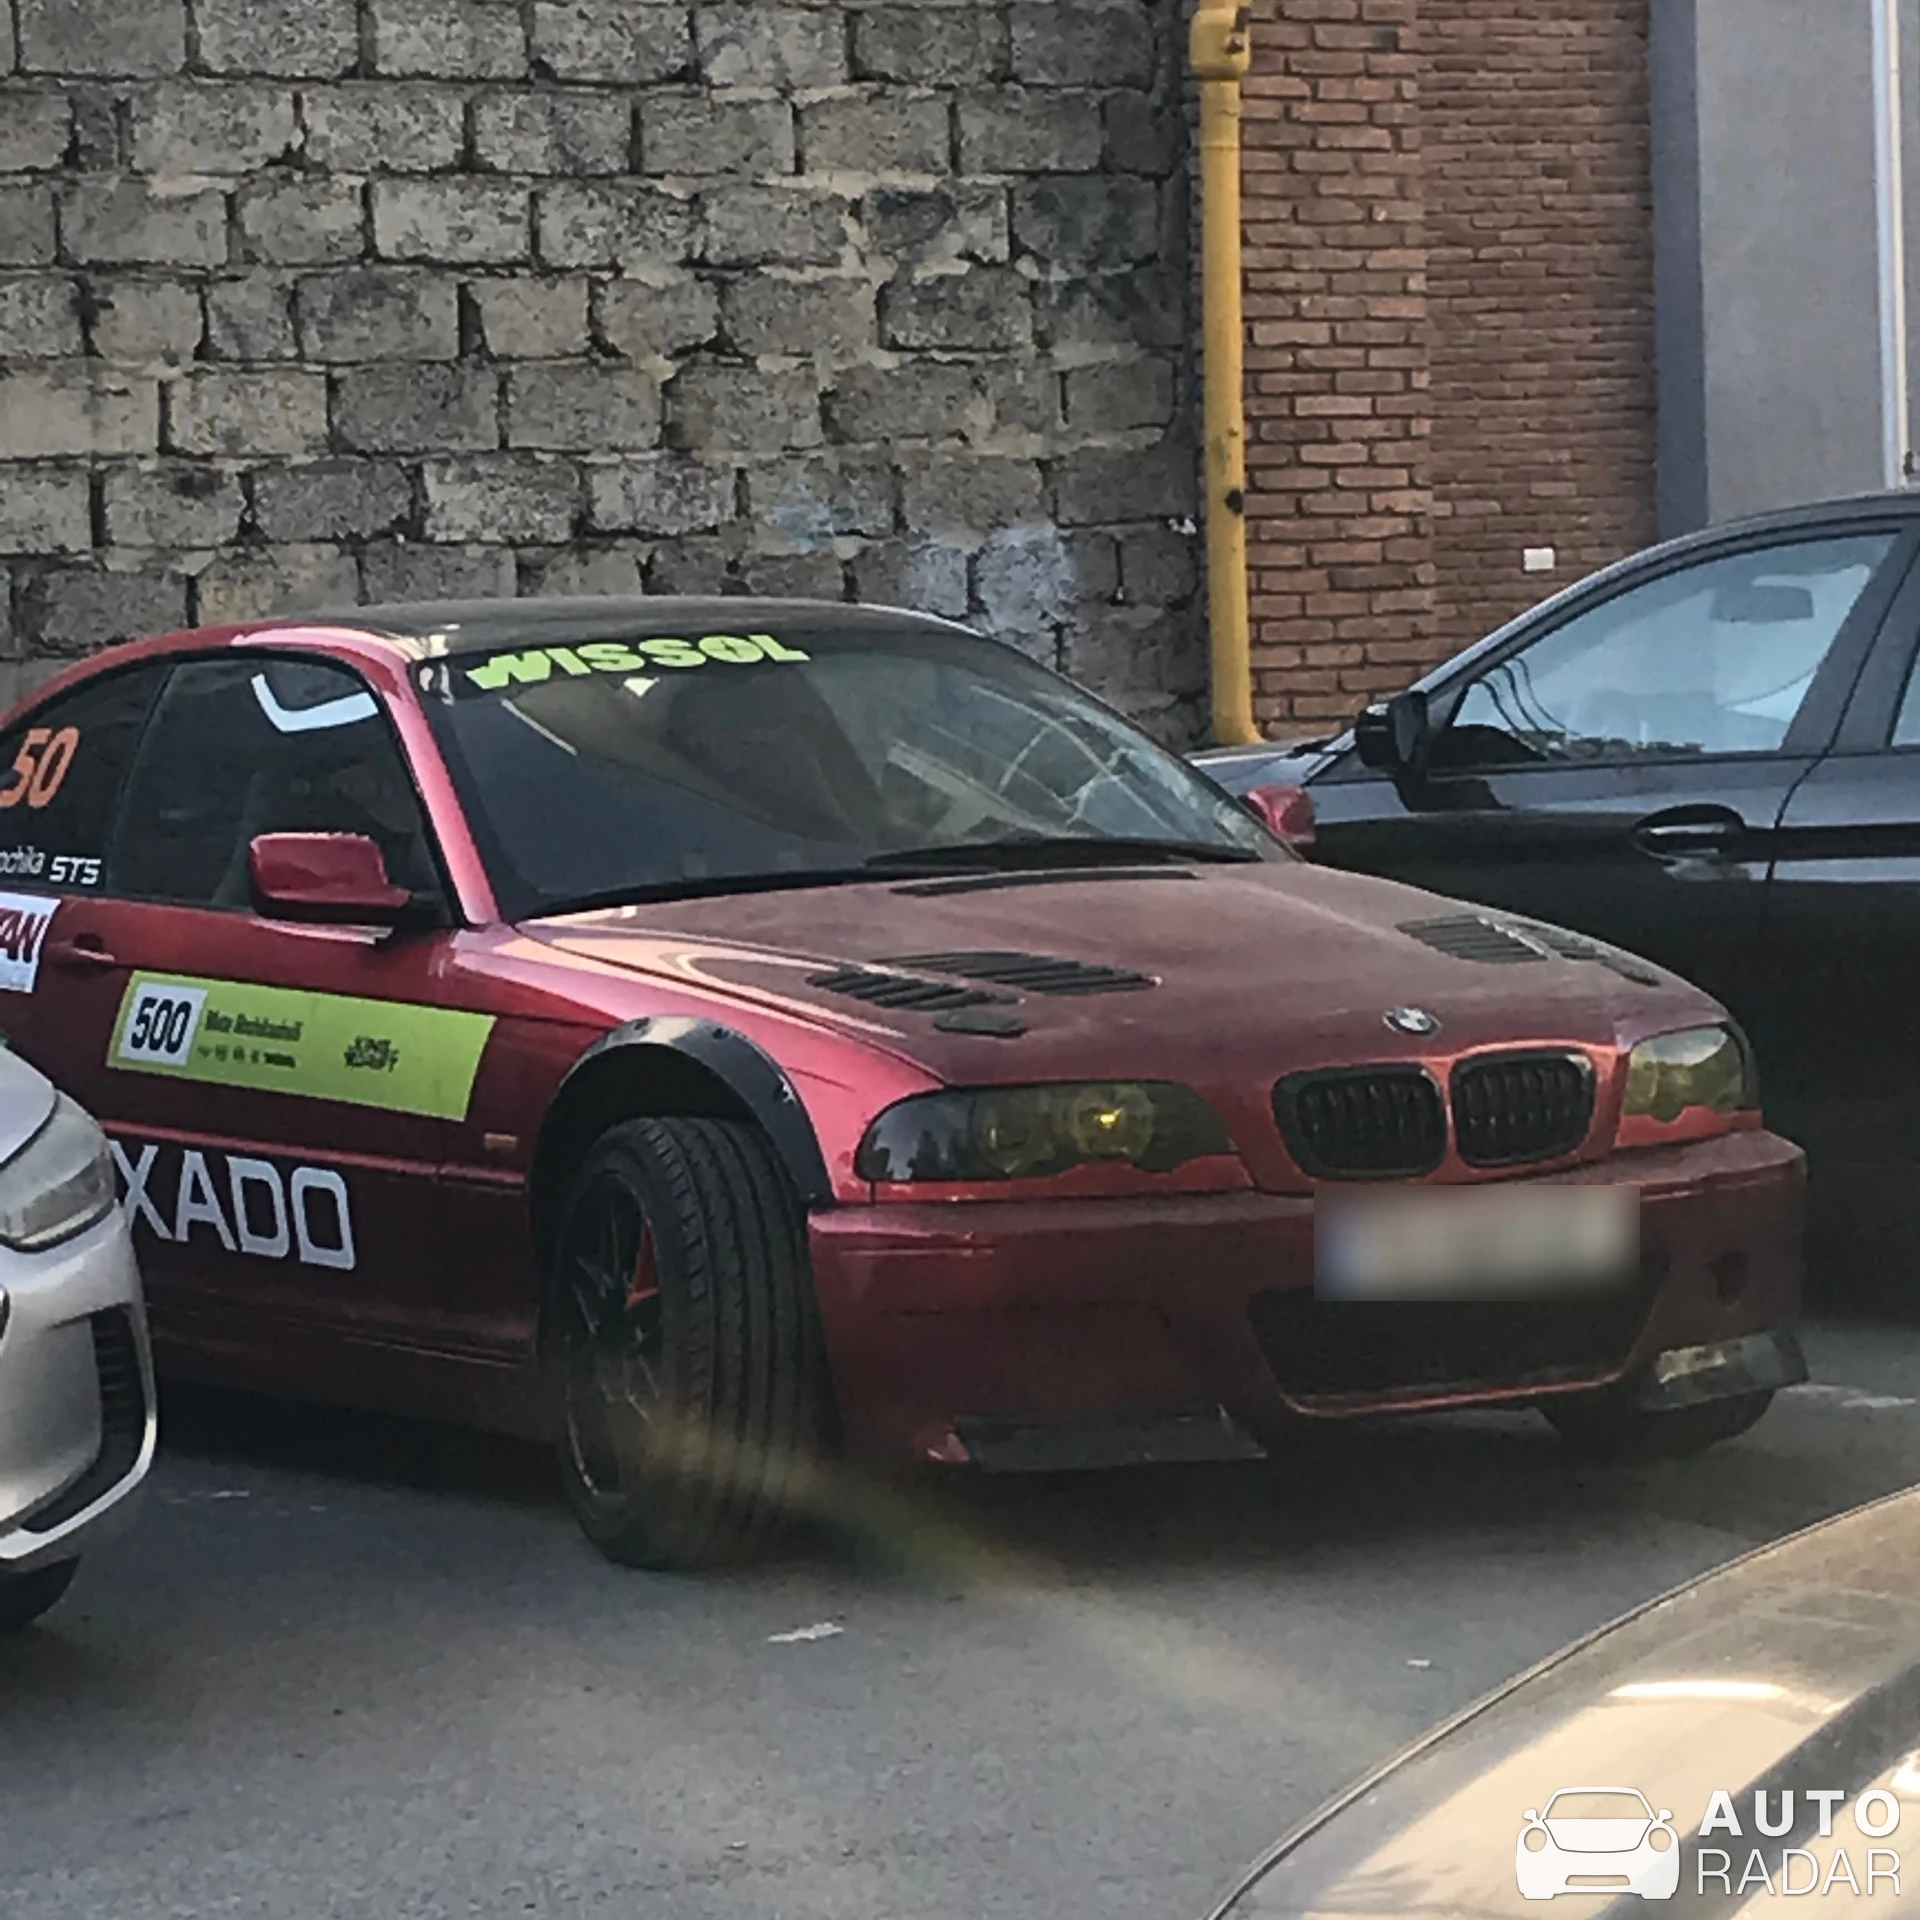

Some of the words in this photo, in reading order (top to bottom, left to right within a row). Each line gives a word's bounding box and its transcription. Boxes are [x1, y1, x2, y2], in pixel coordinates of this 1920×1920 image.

[466, 634, 811, 690] WISSOL
[0, 727, 81, 809] 50
[50, 855, 102, 885] STS
[131, 996, 192, 1054] 500
[108, 1139, 356, 1271] XADO
